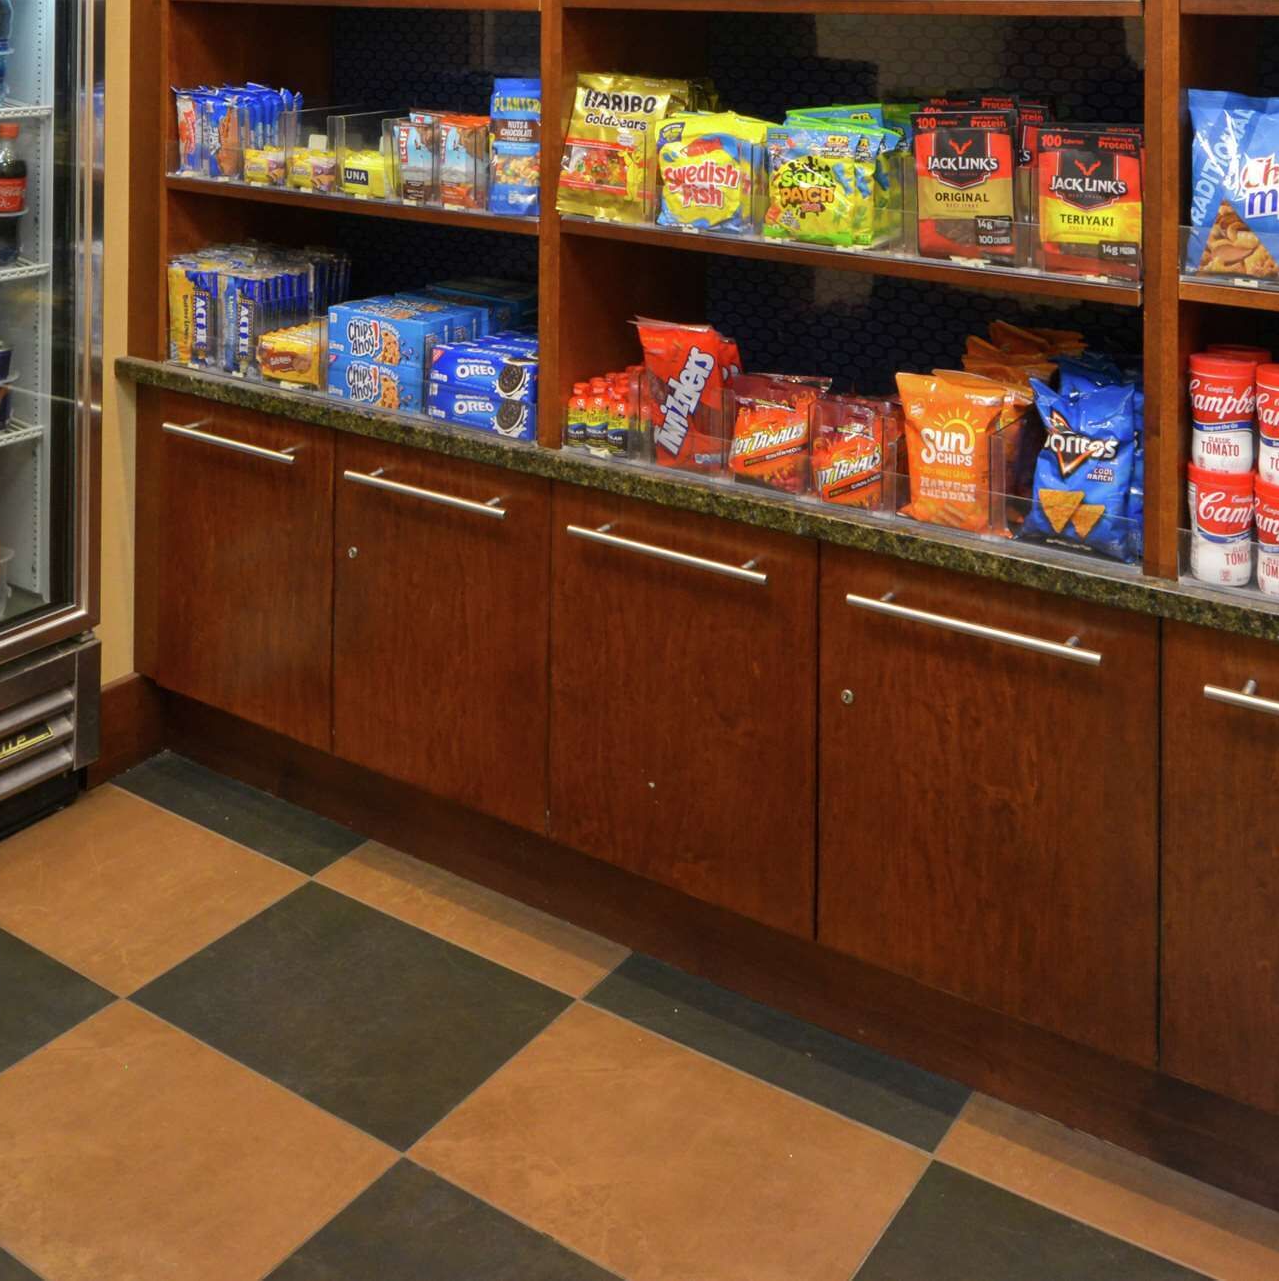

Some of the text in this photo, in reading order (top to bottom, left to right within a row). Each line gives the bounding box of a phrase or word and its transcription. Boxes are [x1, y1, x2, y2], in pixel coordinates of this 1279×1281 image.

[584, 89, 658, 115] HARIBO
[585, 113, 647, 131] Goldbears
[916, 118, 936, 129] 100
[970, 117, 1007, 129] Protein
[500, 129, 532, 137] CHOCOLATE
[1041, 135, 1062, 146] 100
[1097, 139, 1135, 151] Protein
[928, 156, 998, 170] JACK LINK'S
[664, 162, 740, 193] Swedish
[782, 171, 833, 187] SOUR
[1049, 175, 1126, 194] JACK LINK'S
[682, 186, 725, 209] Fish
[781, 187, 834, 206] PATCH
[935, 192, 990, 203] ORIGINAL
[977, 219, 993, 230] 14g
[1060, 214, 1114, 227] TERIYAKI
[979, 235, 993, 244] 100
[1102, 244, 1119, 256] 14g
[348, 321, 374, 337] Chips
[347, 366, 374, 382] Chips
[456, 364, 496, 378] OREO
[454, 400, 494, 414] OREO
[752, 422, 807, 450] TAMALES
[920, 428, 973, 464] Sun
[1201, 441, 1240, 457] TOMATO
[936, 453, 973, 466] CHIPS
[1086, 473, 1113, 483] RANCH
[1093, 468, 1113, 476] COOL
